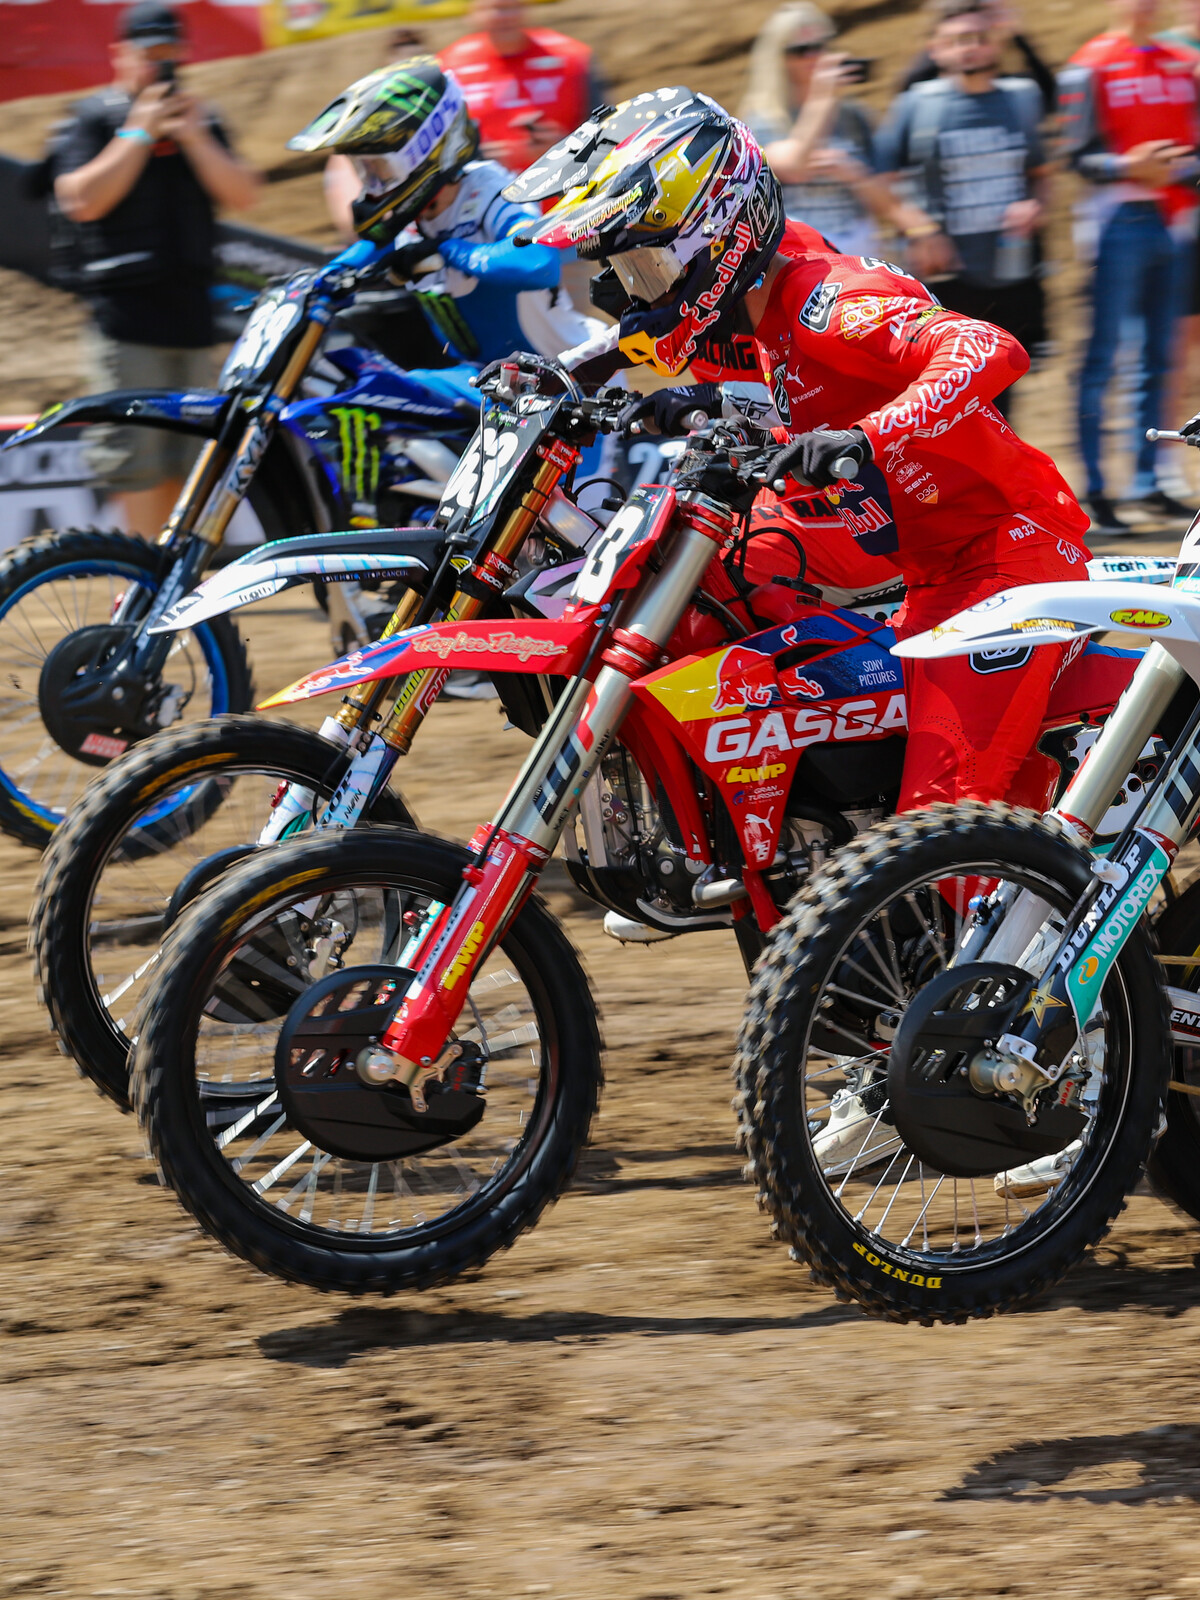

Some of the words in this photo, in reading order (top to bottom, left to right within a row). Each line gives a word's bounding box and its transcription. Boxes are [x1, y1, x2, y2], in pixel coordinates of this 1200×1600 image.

[700, 340, 758, 371] ACING
[904, 472, 933, 495] SENA
[1111, 610, 1171, 627] FMF
[862, 658, 884, 673] SONY
[858, 671, 898, 687] PICTURES
[704, 694, 909, 763] GASGA
[748, 790, 785, 802] TURISMO
[753, 785, 778, 795] GRAN
[1055, 843, 1141, 973] DUNLOP
[1092, 860, 1165, 960] MOTOREX
[1059, 1080, 1075, 1106] brem
[852, 1242, 943, 1289] DUNLOP
